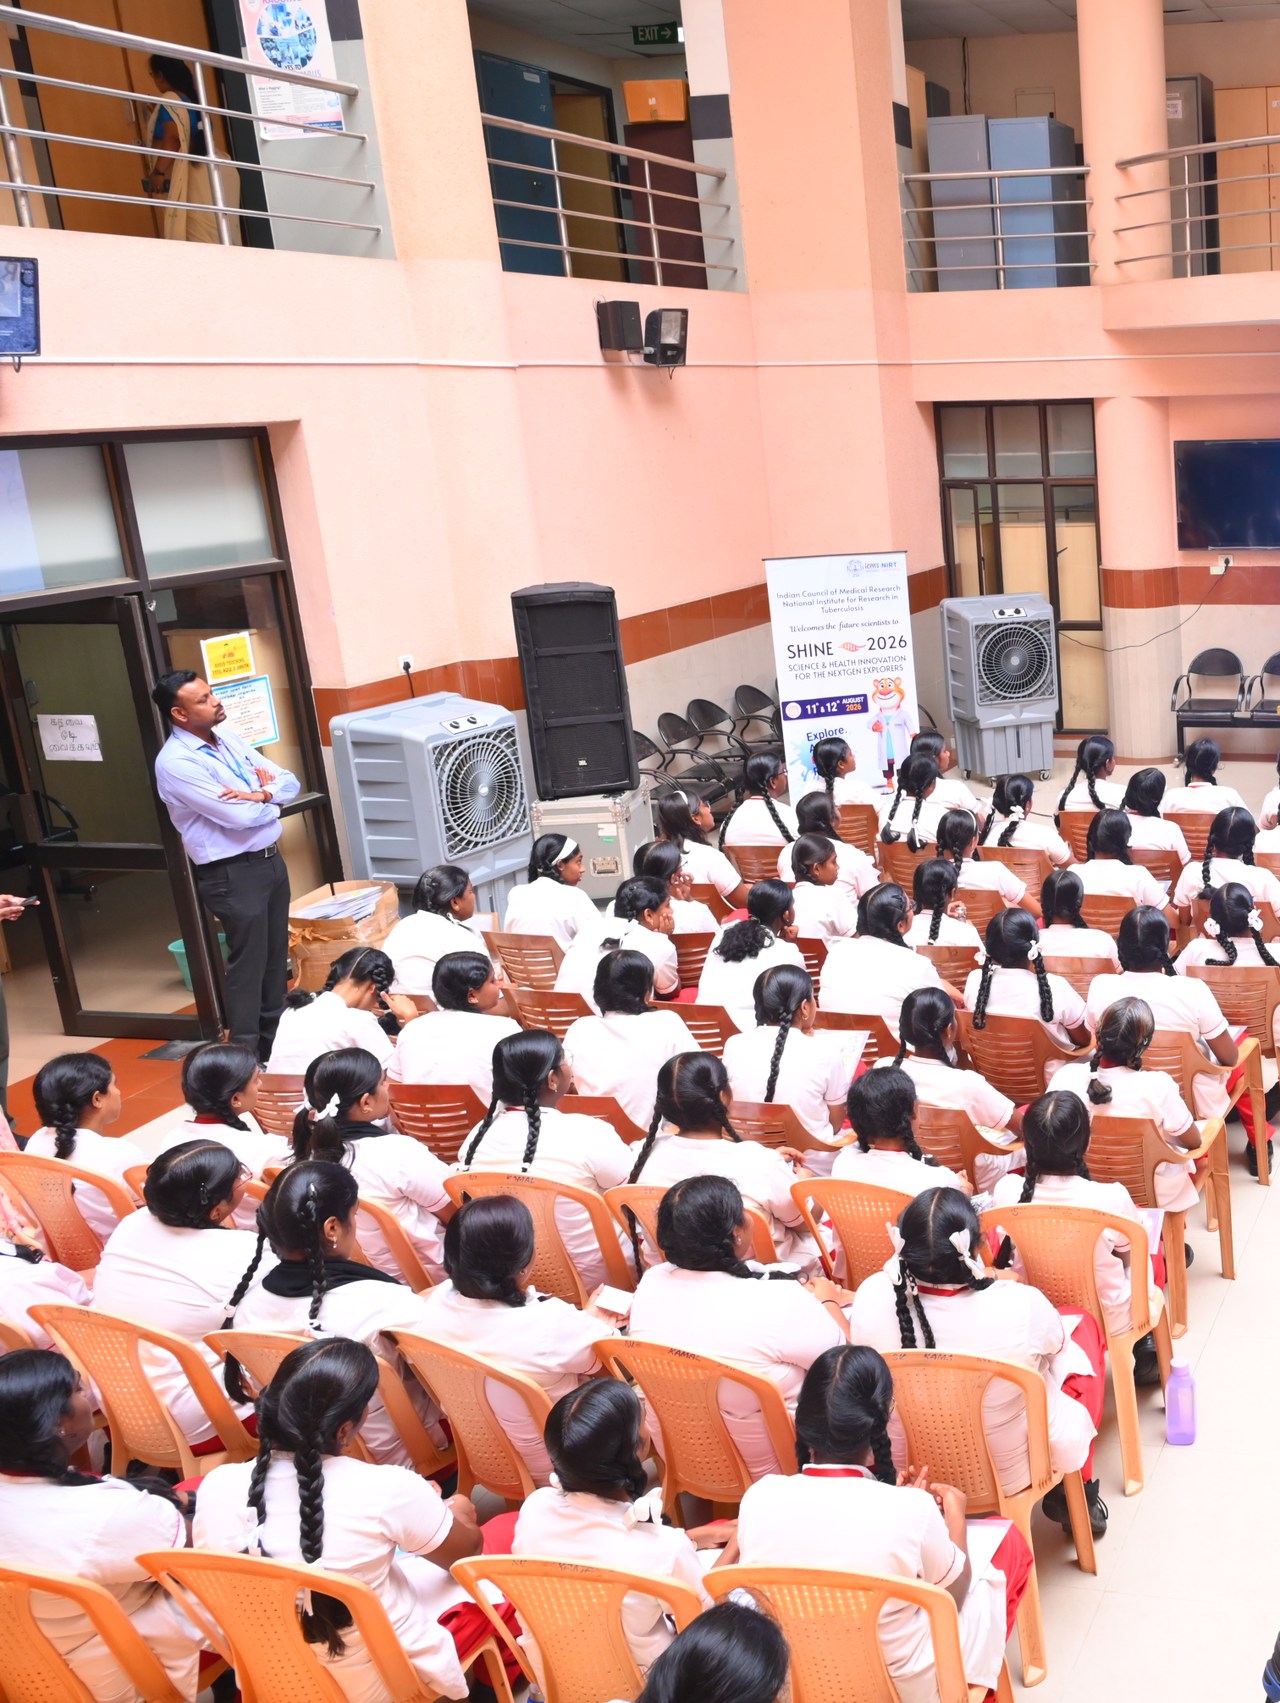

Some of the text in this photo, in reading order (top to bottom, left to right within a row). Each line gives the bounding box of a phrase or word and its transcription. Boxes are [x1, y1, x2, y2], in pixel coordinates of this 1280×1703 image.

[638, 26, 659, 41] EXIT
[802, 590, 828, 598] Council
[840, 587, 867, 595] Medical
[858, 595, 890, 603] Research
[821, 605, 864, 614] Tuberculosis
[839, 621, 859, 631] future
[861, 619, 890, 627] scientists
[787, 635, 907, 659] SHINE 2026
[789, 662, 819, 672] SCIENCE
[829, 660, 855, 668] HEALTH
[858, 655, 906, 665] INNOVATION
[828, 668, 861, 677] NEXTGEN
[864, 664, 903, 674] EXPLORERS
[806, 726, 848, 742] Explore.
